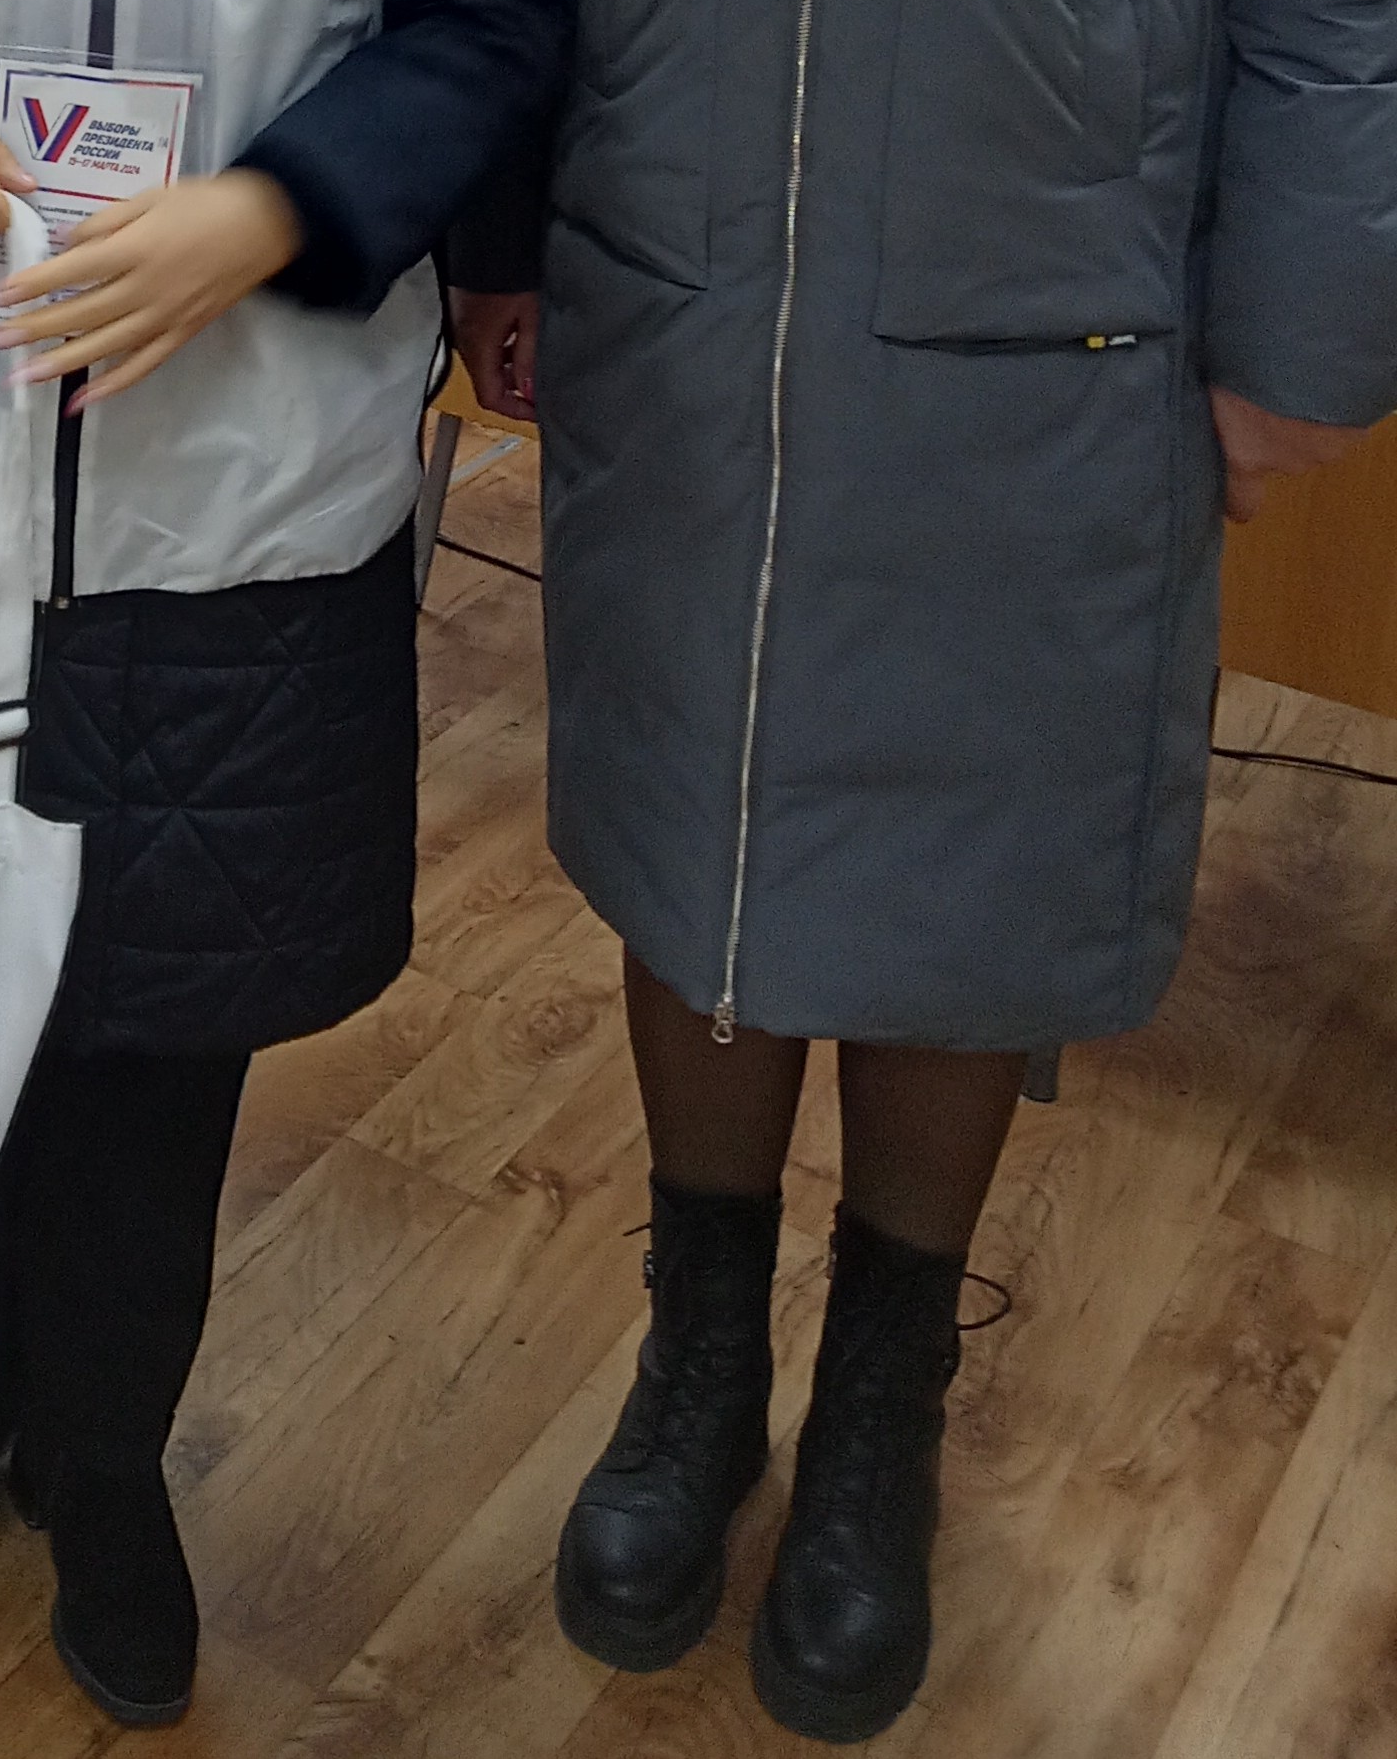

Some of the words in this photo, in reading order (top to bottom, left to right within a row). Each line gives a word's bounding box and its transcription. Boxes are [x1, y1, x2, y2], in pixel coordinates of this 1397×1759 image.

[88, 119, 142, 137] ВЫБОРЫ
[80, 132, 155, 152] ПРЕЗИДЕНТА
[73, 144, 122, 160] РОССИИ
